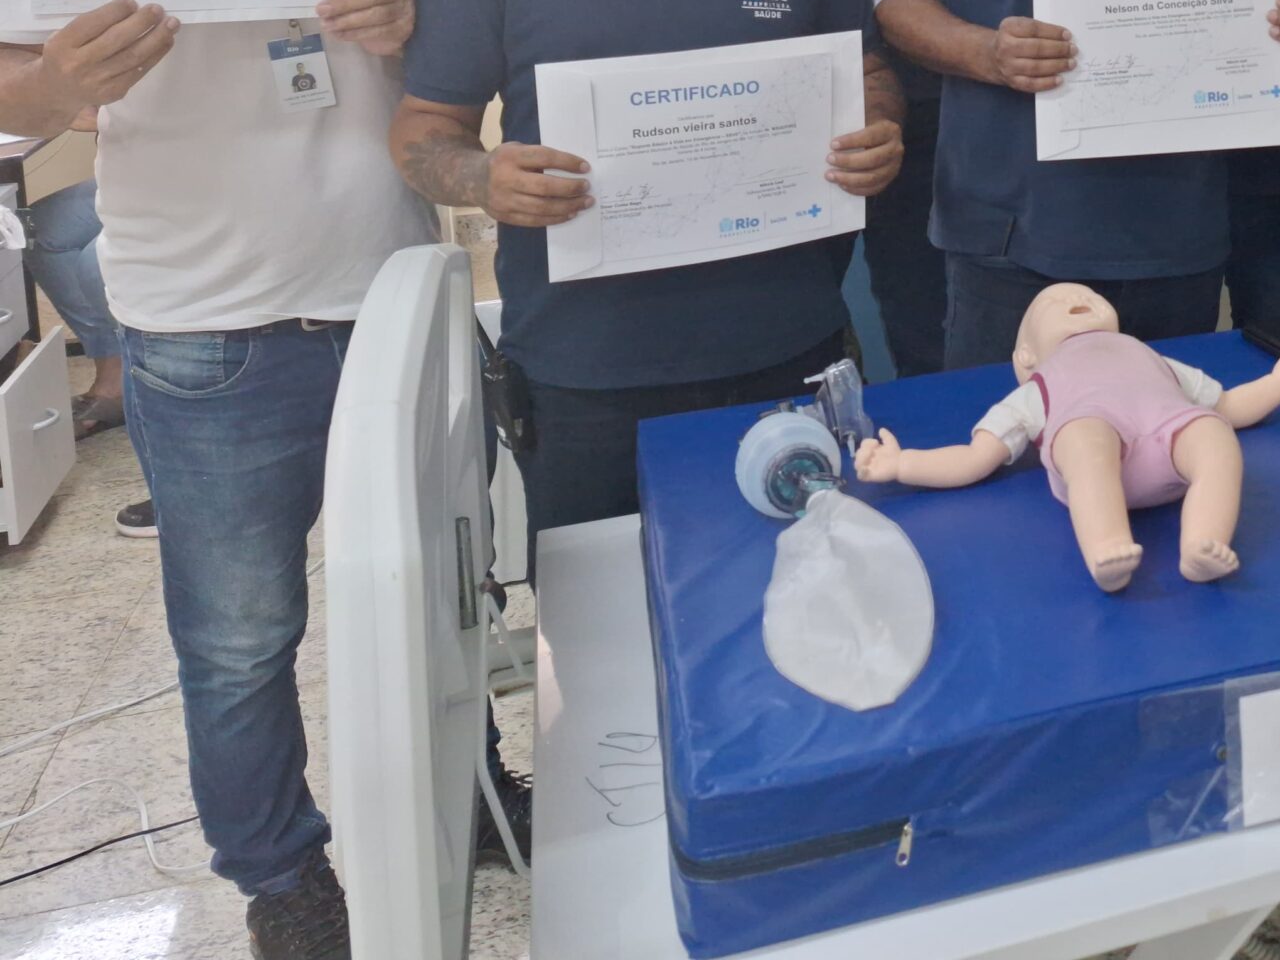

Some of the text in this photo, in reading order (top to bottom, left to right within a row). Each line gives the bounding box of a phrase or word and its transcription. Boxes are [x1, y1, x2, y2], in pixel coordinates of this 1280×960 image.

[754, 9, 782, 19] SAÚDE
[1105, 3, 1139, 14] Nelson
[1142, 1, 1154, 11] da
[630, 80, 760, 107] CERTIFICADO
[1208, 91, 1229, 102] Rio
[632, 115, 758, 139] Rudson vieira santos
[735, 217, 760, 230] Rio
